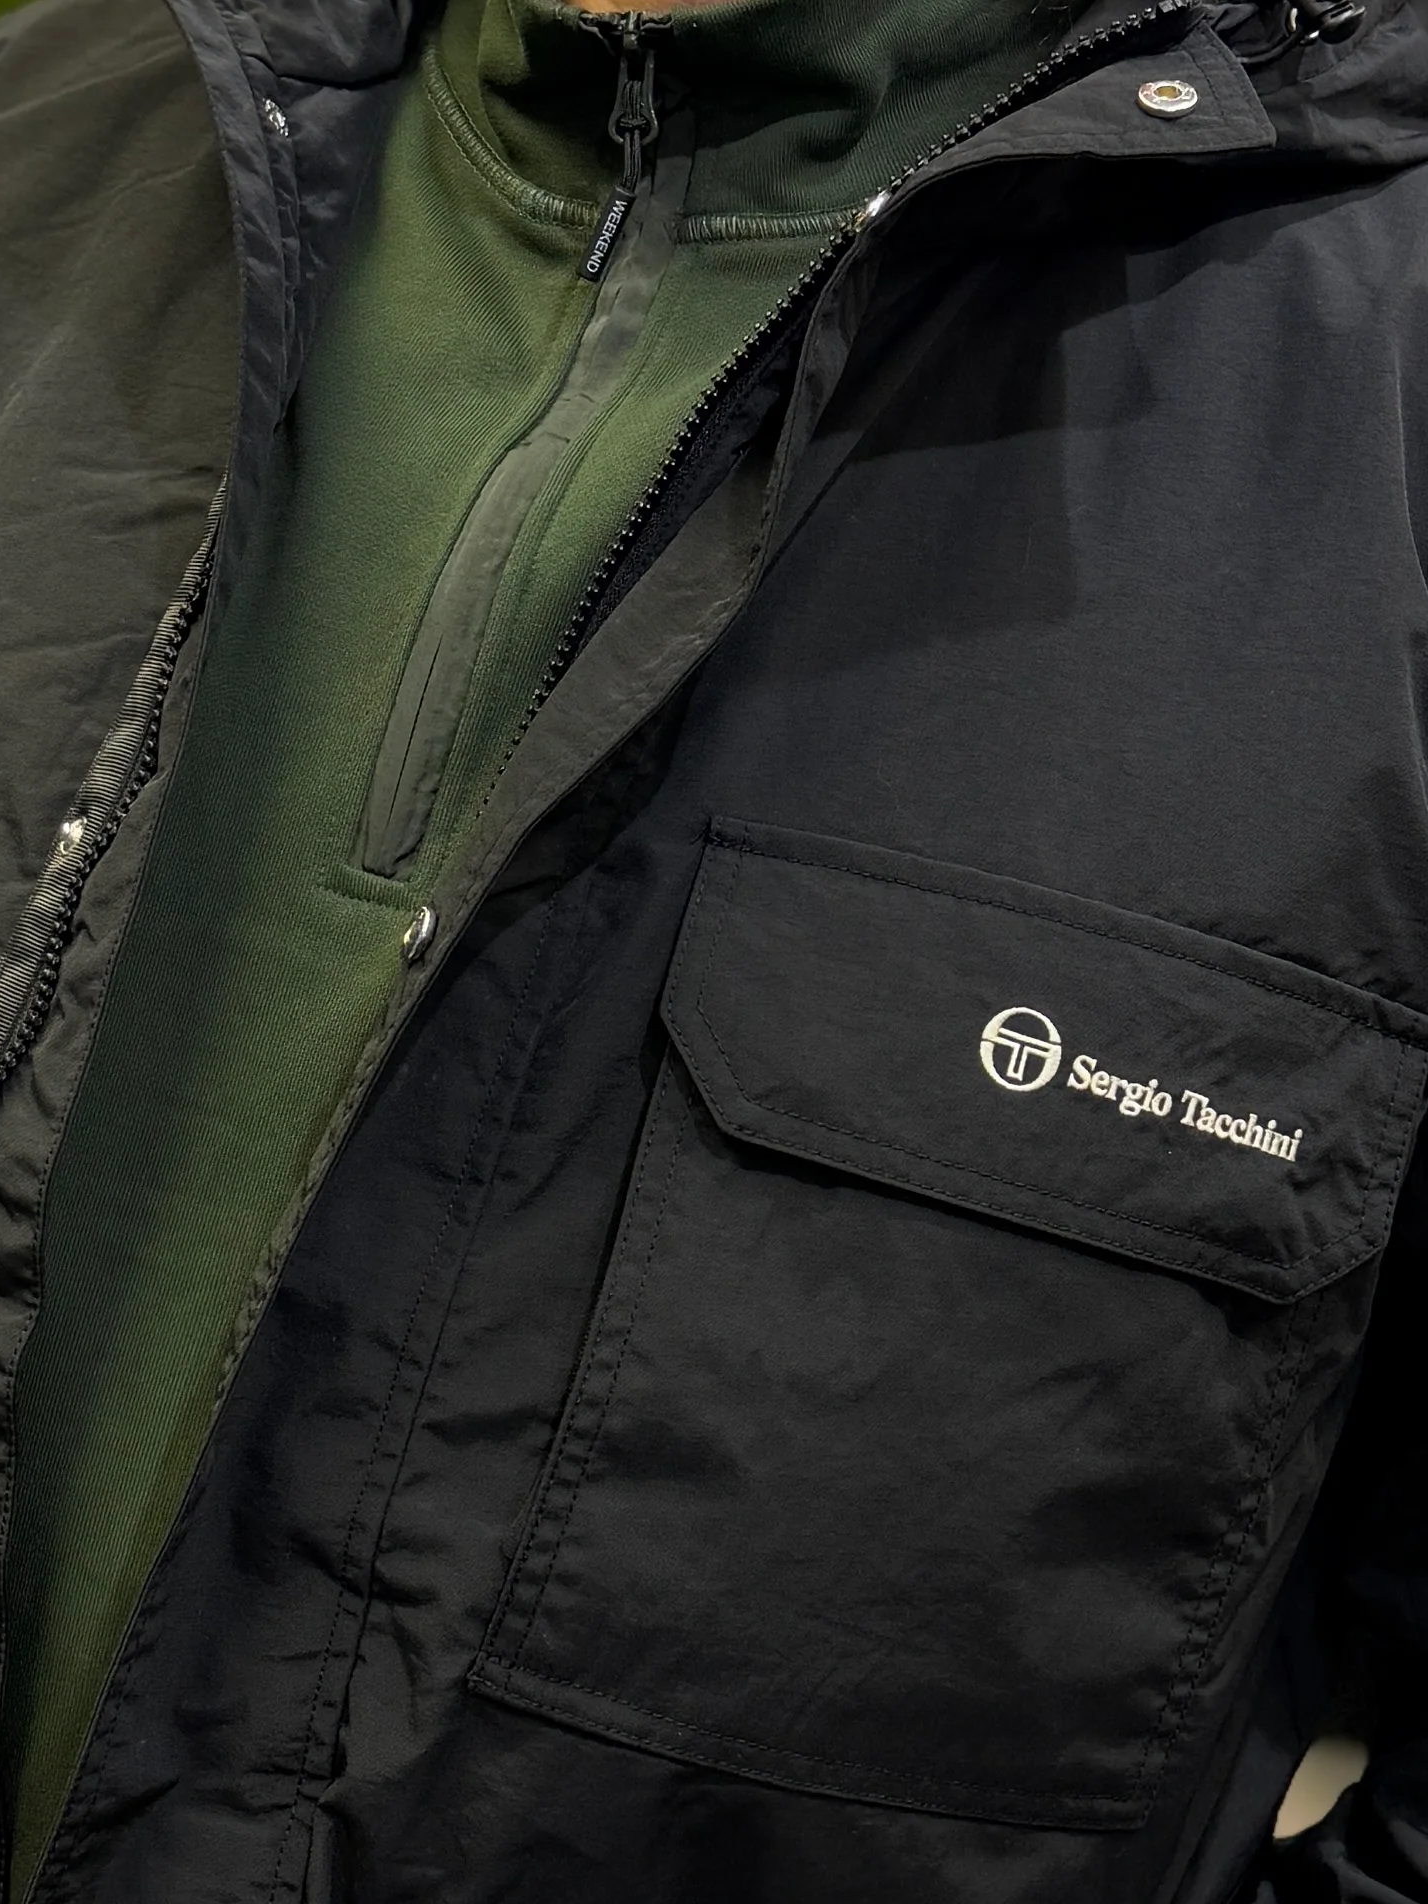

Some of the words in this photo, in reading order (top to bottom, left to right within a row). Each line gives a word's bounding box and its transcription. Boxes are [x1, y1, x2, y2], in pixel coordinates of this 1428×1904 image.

[587, 200, 628, 273] WEEKEND
[1067, 1055, 1173, 1116] Sergio
[1180, 1090, 1303, 1162] Tacchini
